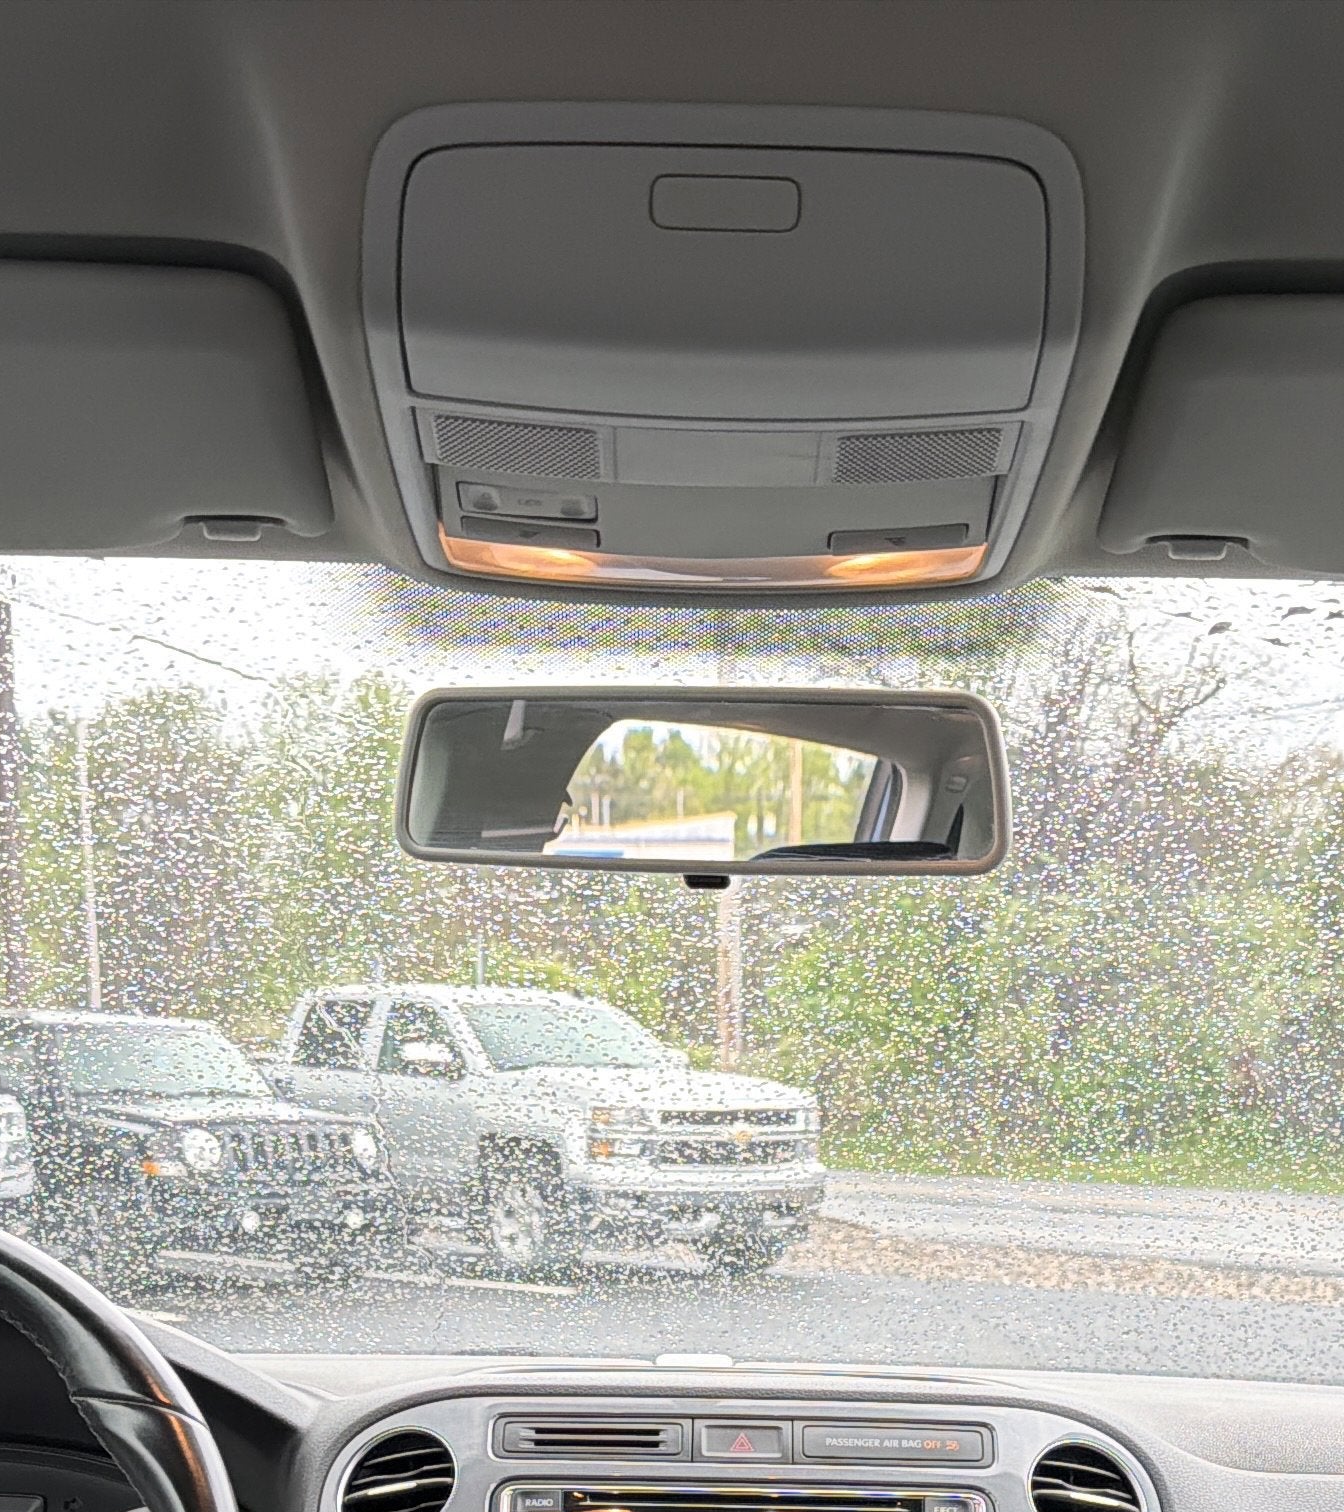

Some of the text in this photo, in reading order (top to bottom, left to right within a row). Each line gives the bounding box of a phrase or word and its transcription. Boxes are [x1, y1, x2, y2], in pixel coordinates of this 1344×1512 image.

[825, 1437, 881, 1447] PASSENGER
[882, 1439, 899, 1448] AIR
[901, 1440, 921, 1448] BAG
[525, 1498, 553, 1507] RADIO
